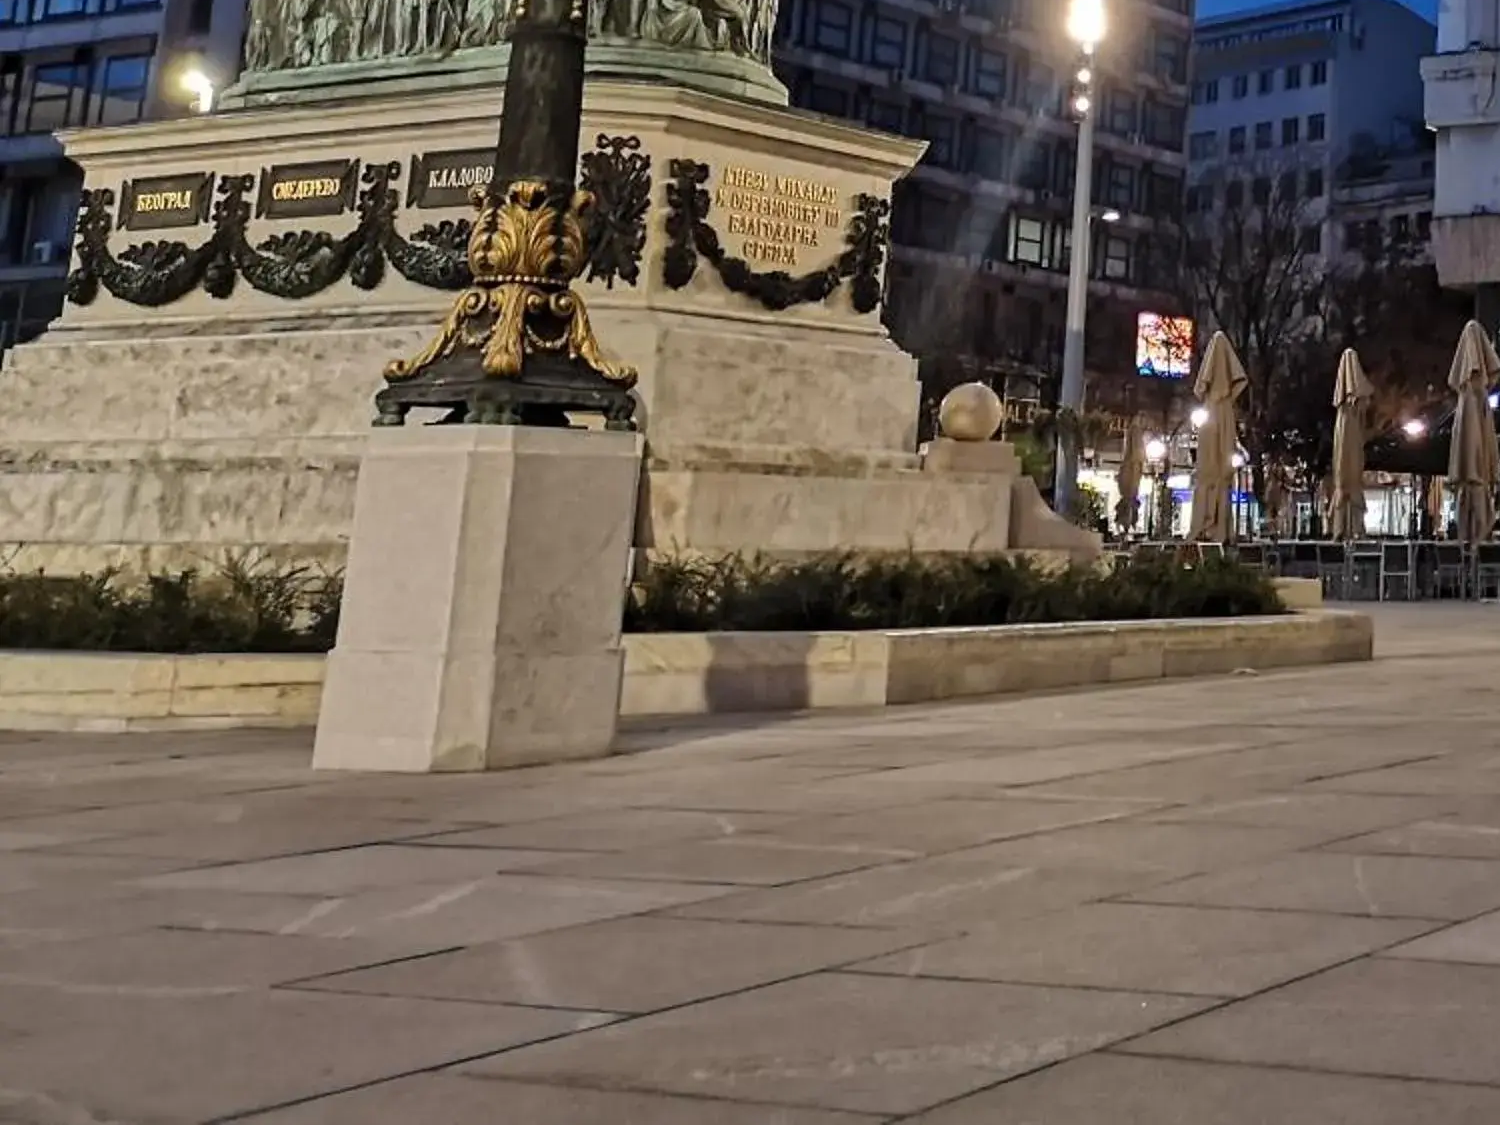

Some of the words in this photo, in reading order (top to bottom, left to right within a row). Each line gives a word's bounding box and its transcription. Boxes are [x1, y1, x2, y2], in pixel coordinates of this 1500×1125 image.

[429, 165, 494, 188] КЛАДОВО
[271, 178, 341, 200] СМЕДЕРЕВО
[136, 190, 193, 212] БЕОГРАД
[728, 214, 819, 247] БЛАГОДАРНА
